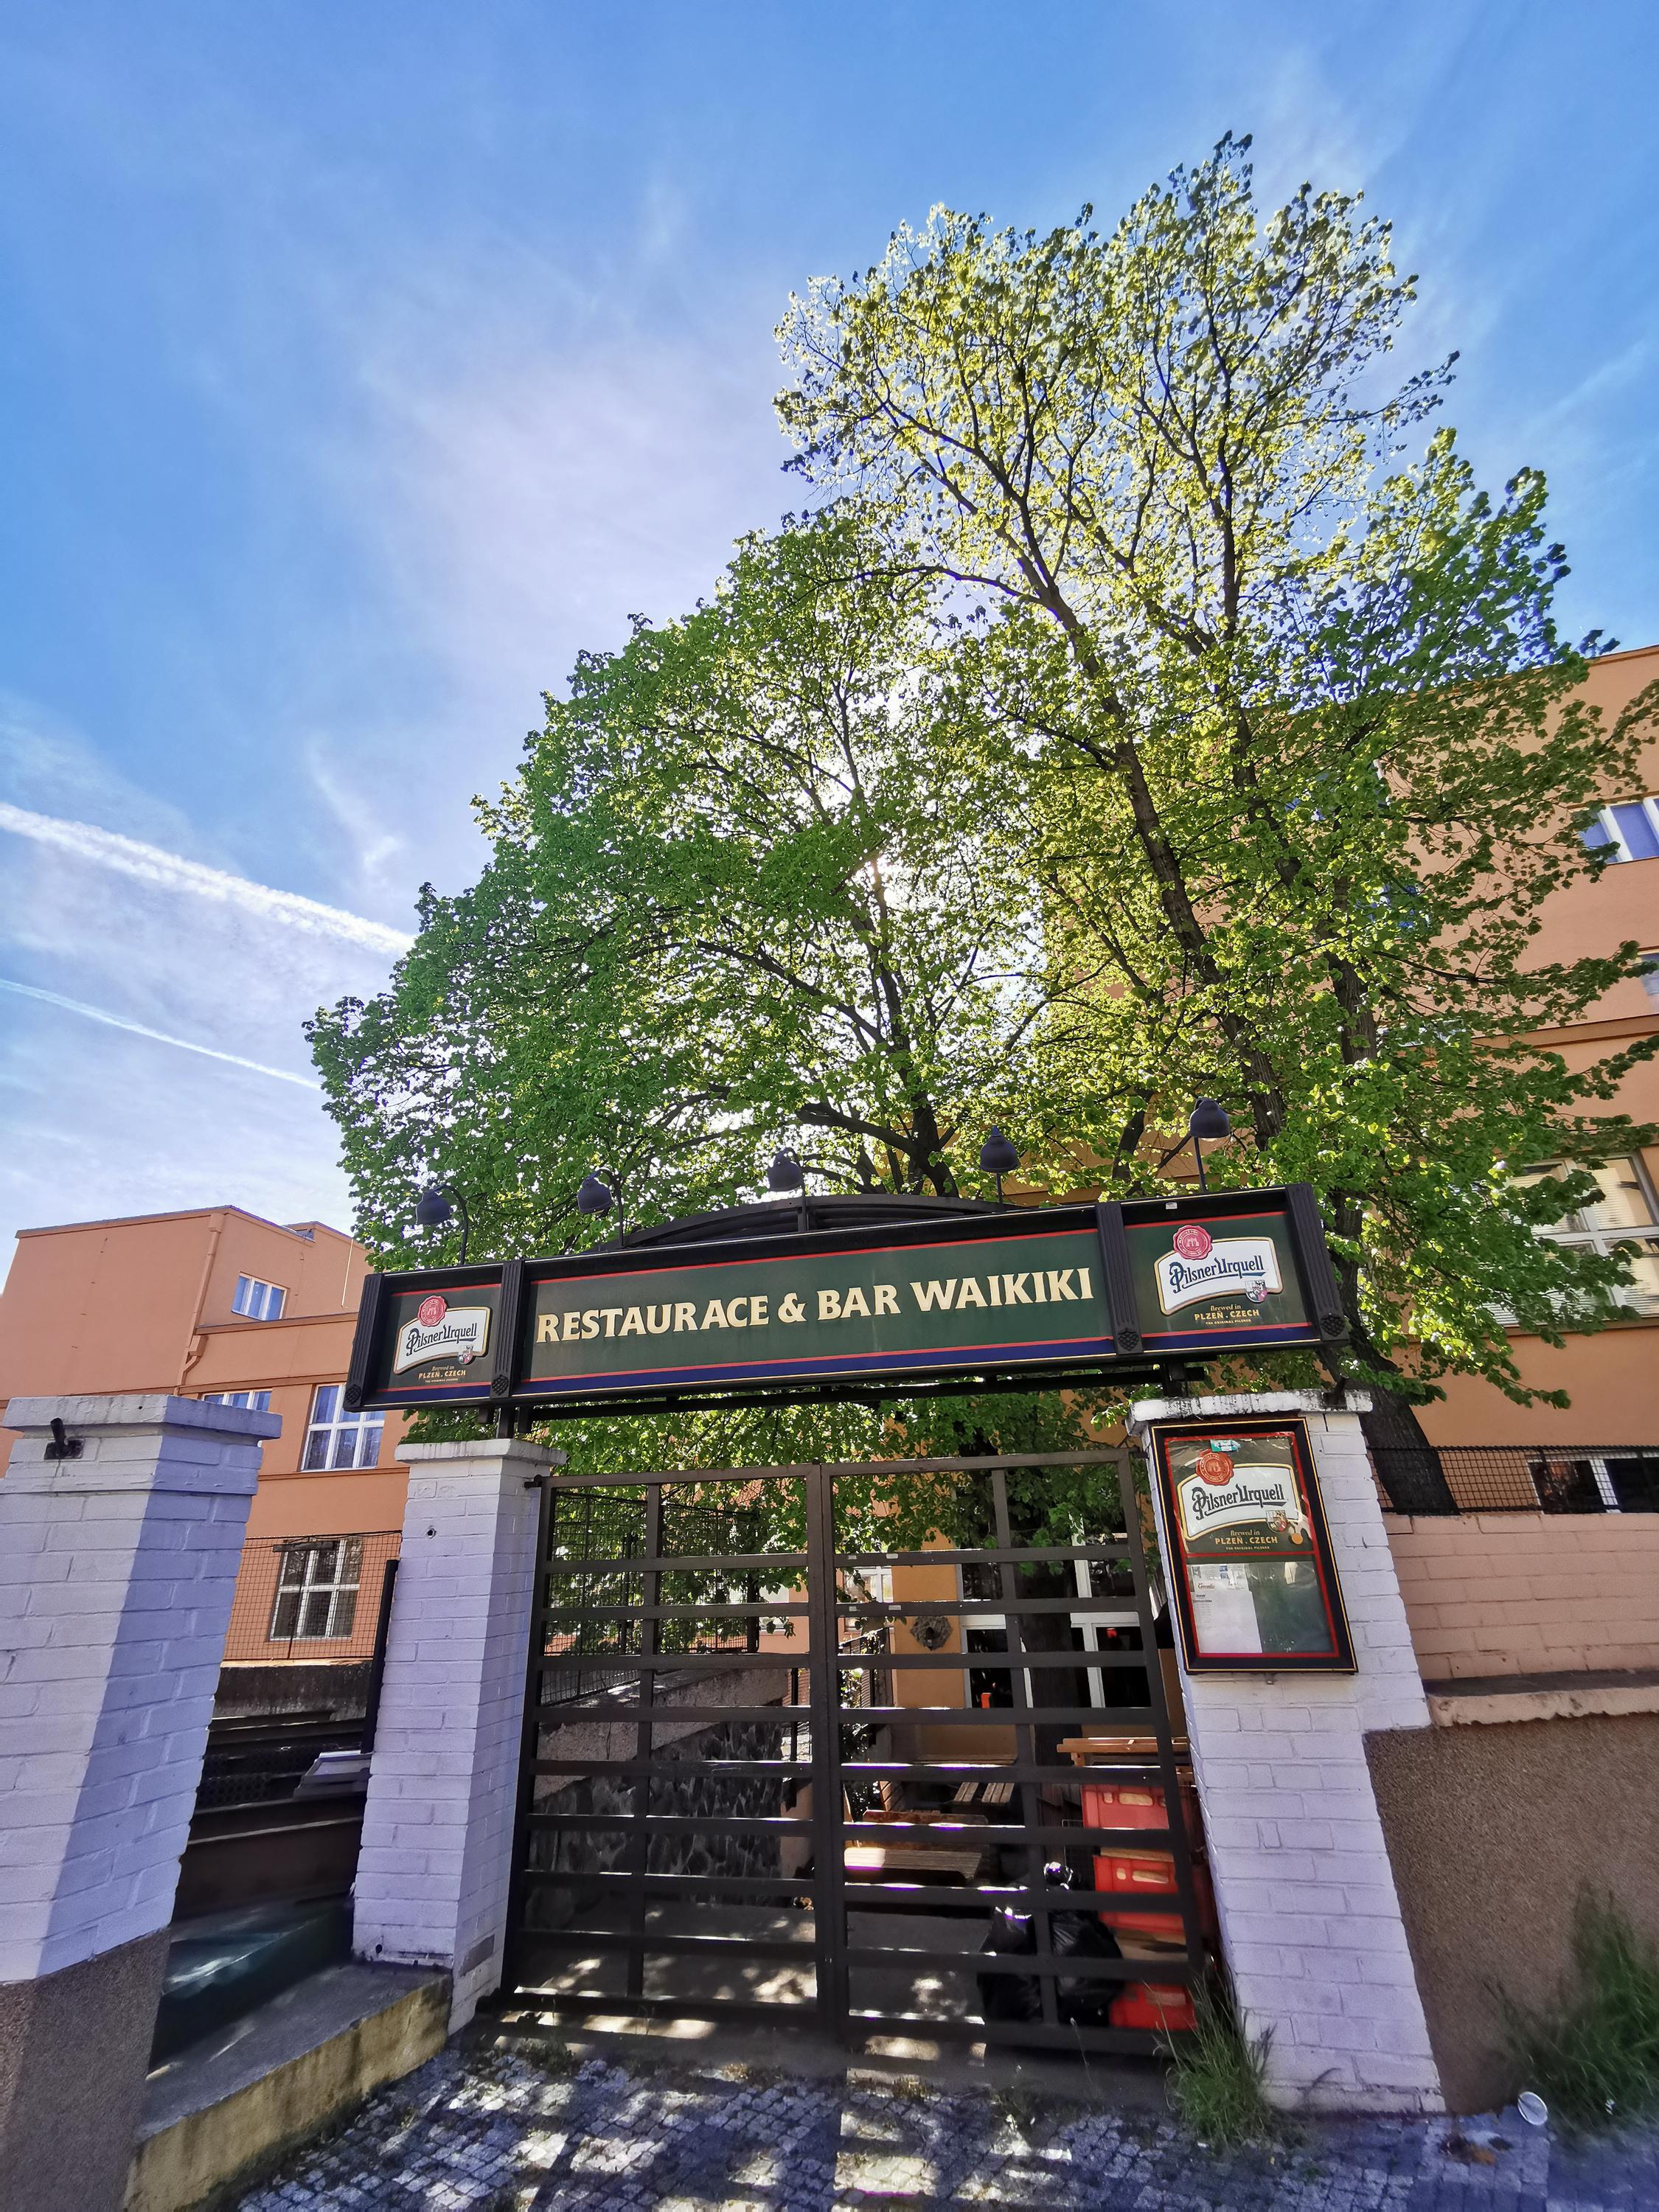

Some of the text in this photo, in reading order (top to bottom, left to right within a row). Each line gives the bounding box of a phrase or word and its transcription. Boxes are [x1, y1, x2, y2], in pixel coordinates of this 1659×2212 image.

[1169, 1255, 1265, 1294] Pilsner Urquell
[536, 1267, 1094, 1343] RESTAURACE & BAR WAIKIKI
[1194, 1309, 1260, 1321] PLZEŇ CZECH
[1210, 1304, 1234, 1312] Brewed
[406, 1323, 478, 1357] Pilsner Urquell
[1192, 1483, 1285, 1521] Pilsner Urquell
[1230, 1529, 1253, 1537] Brewed
[1249, 1536, 1279, 1544] CZECH
